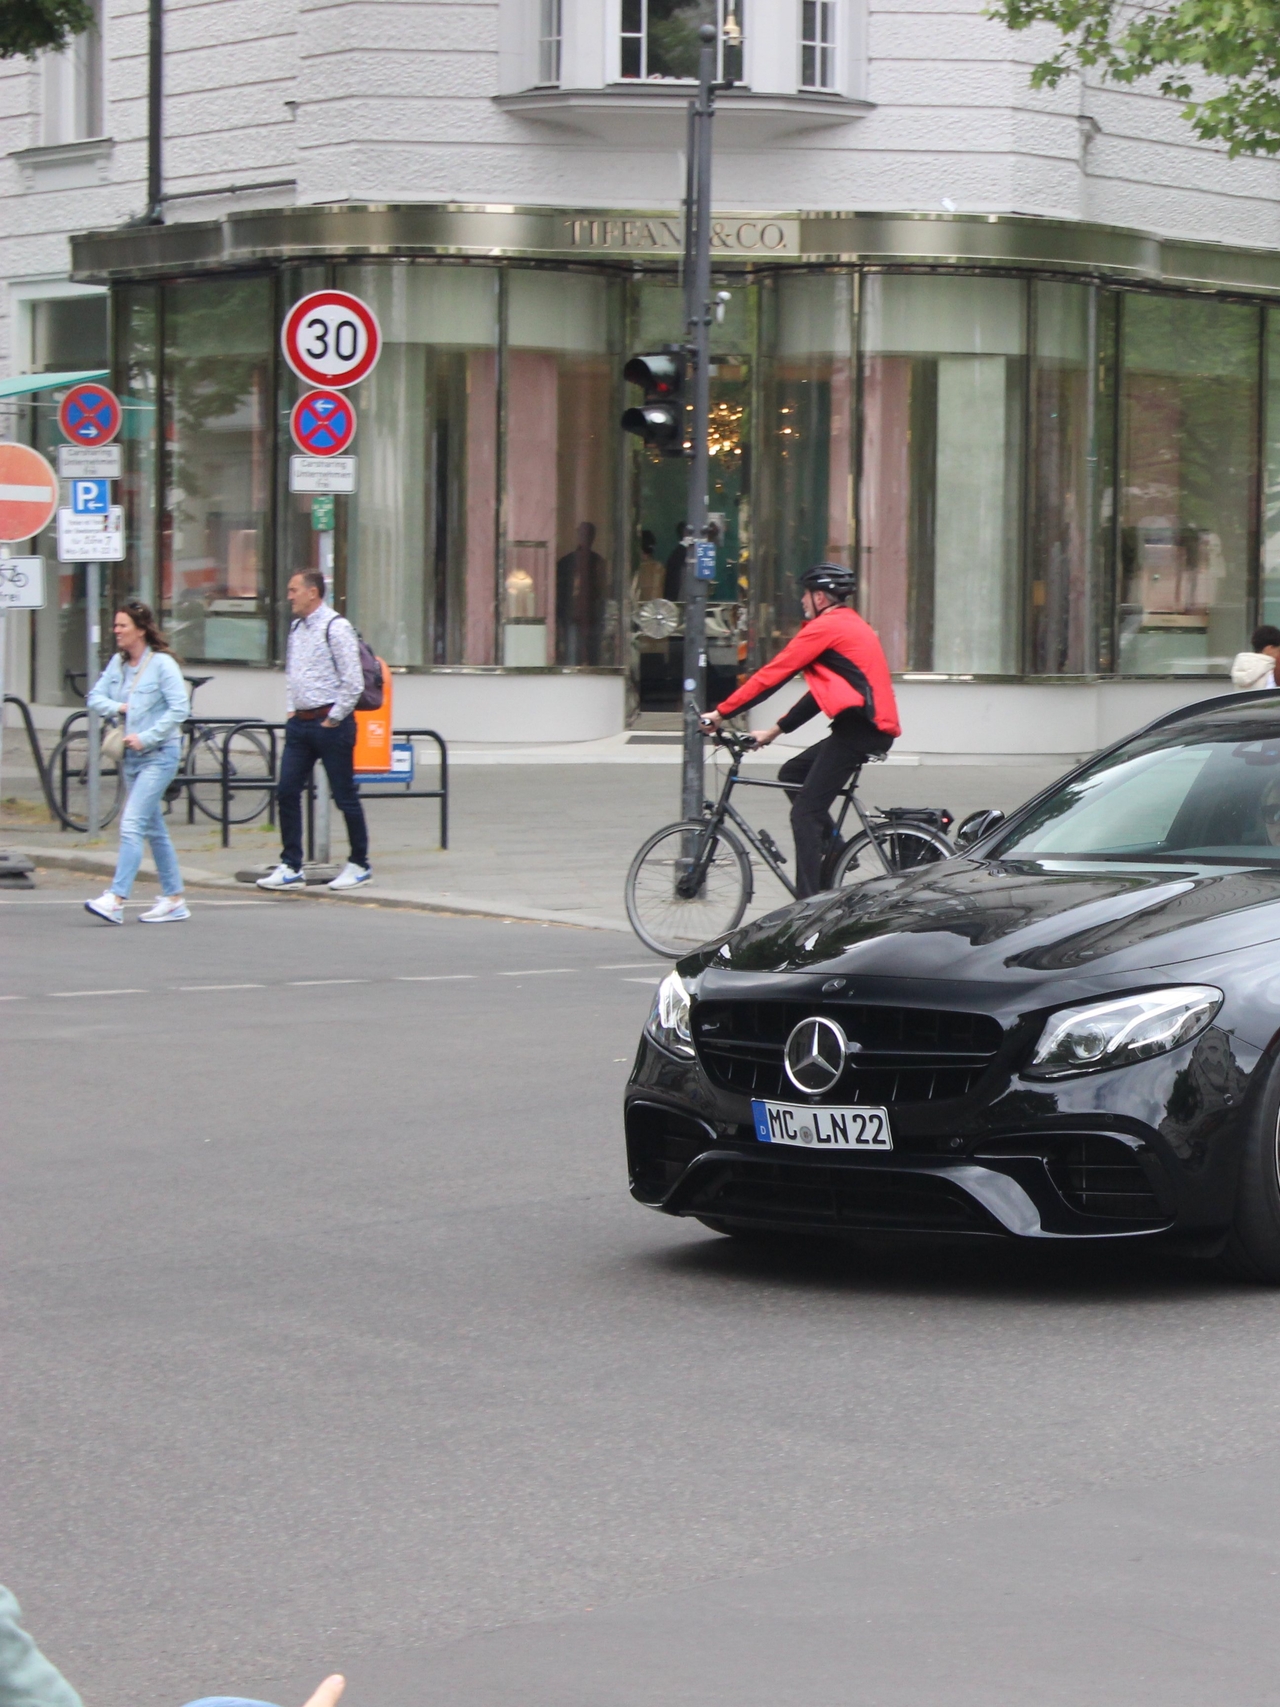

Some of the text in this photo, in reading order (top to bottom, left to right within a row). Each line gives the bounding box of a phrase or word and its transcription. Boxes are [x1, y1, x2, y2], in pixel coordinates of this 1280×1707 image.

[564, 219, 681, 248] TIFFAN
[306, 318, 357, 361] 30
[297, 470, 353, 479] Unternehmen
[301, 460, 347, 470] Carsharing
[76, 481, 99, 511] P
[767, 1107, 798, 1141] MC
[812, 1113, 850, 1144] LN
[852, 1113, 887, 1145] 22
